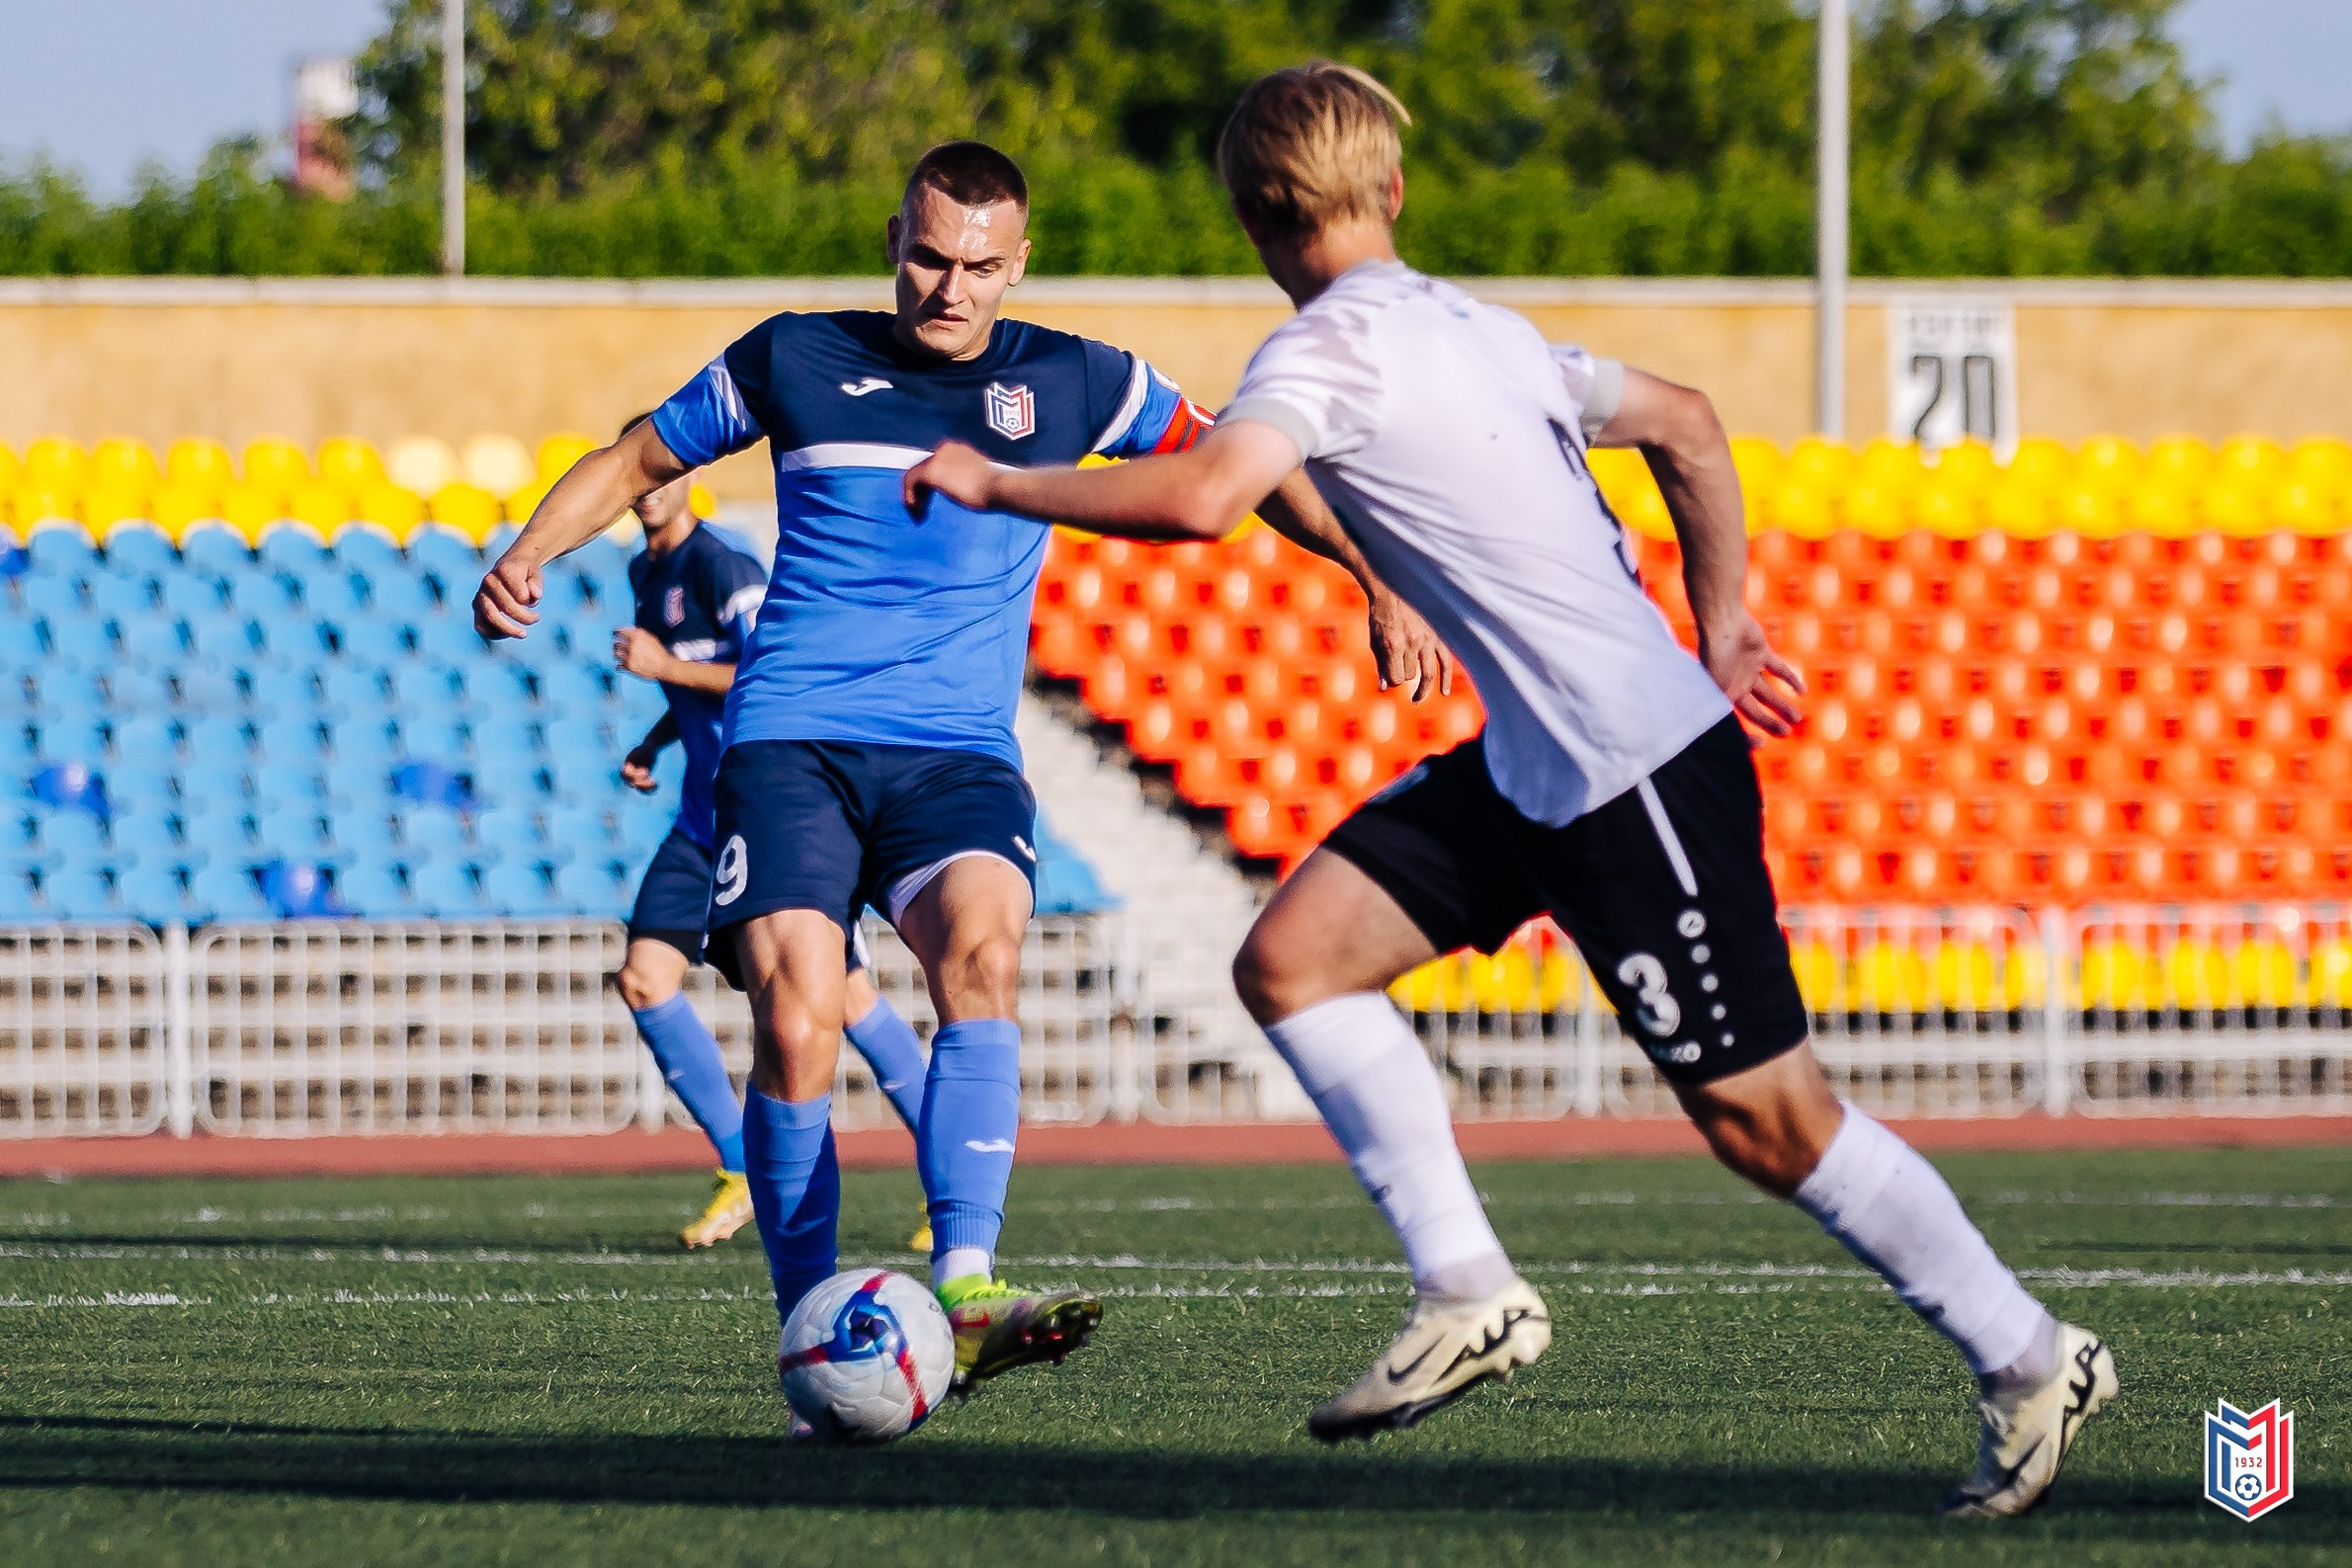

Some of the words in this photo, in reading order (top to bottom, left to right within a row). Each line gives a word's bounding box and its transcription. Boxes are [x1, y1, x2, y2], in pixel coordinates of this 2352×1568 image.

[1908, 350, 1996, 442] 20
[714, 834, 748, 906] 9
[1617, 952, 1681, 1037] 3
